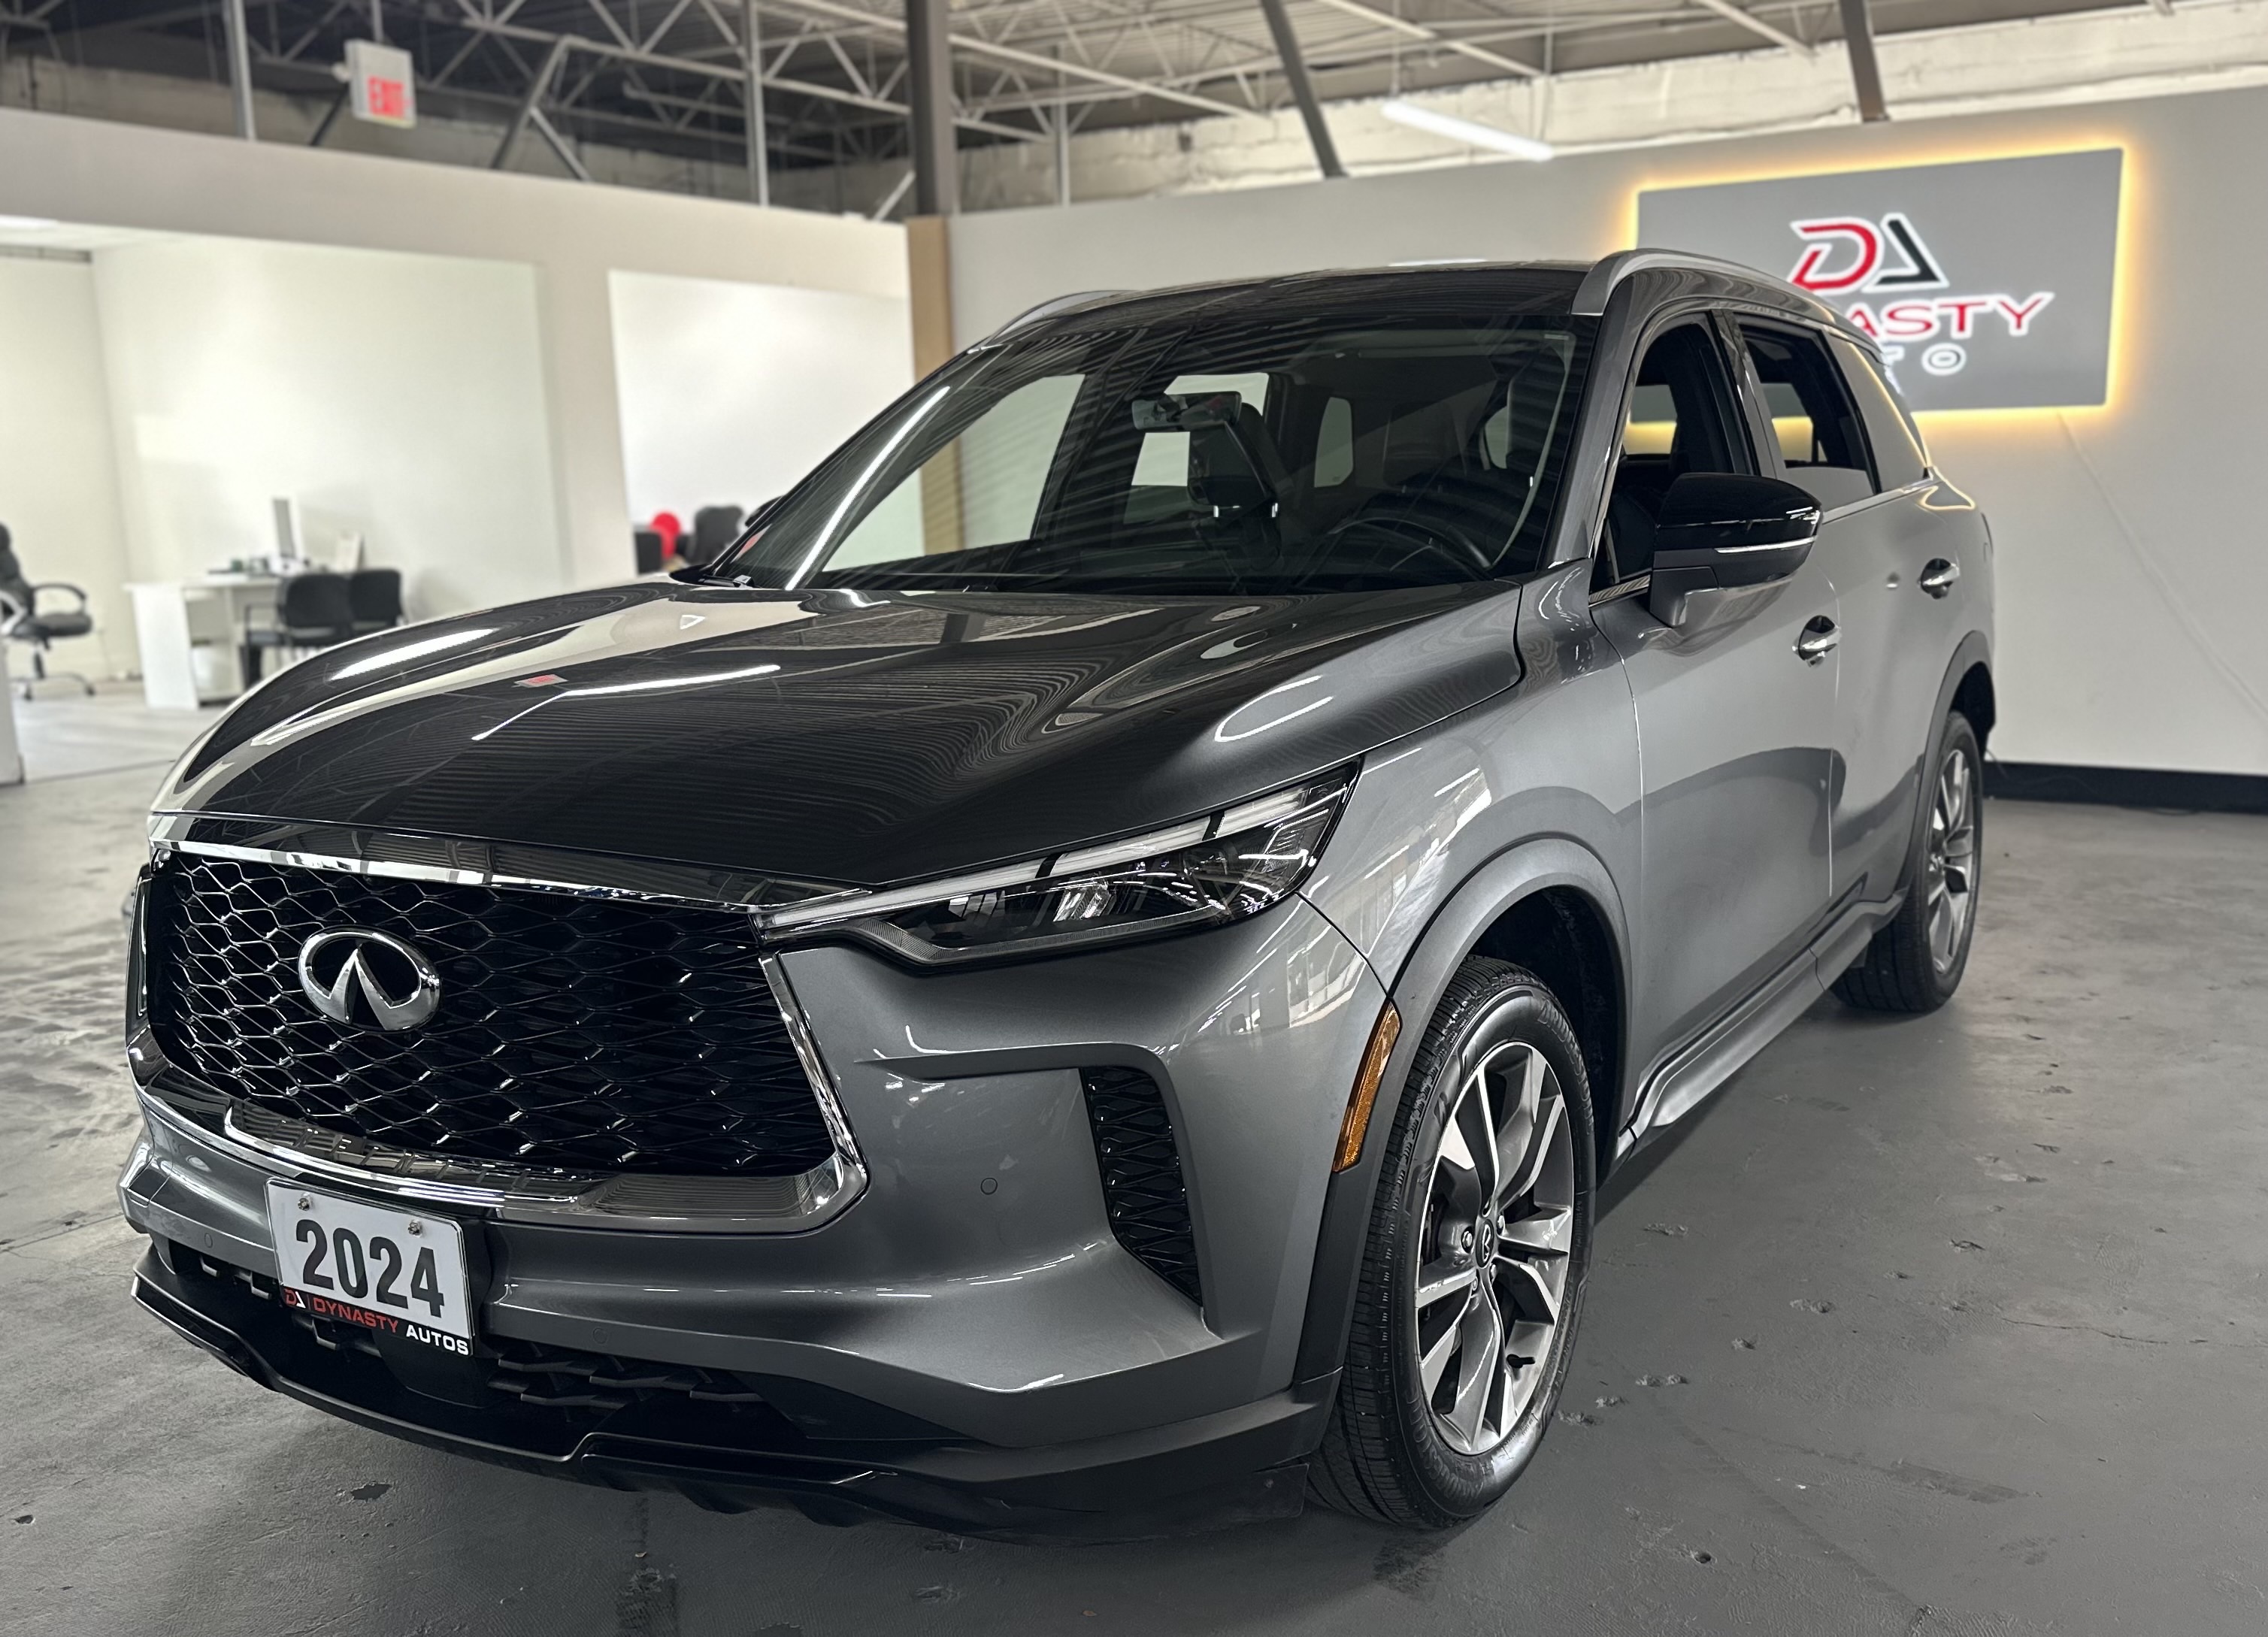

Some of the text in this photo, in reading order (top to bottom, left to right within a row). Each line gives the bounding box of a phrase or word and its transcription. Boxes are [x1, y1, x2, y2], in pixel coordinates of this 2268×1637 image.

[1844, 292, 2055, 341] ASTY
[295, 1218, 445, 1318] 2024
[313, 1297, 398, 1333] DYNASTY
[405, 1324, 469, 1356] AUTOS
